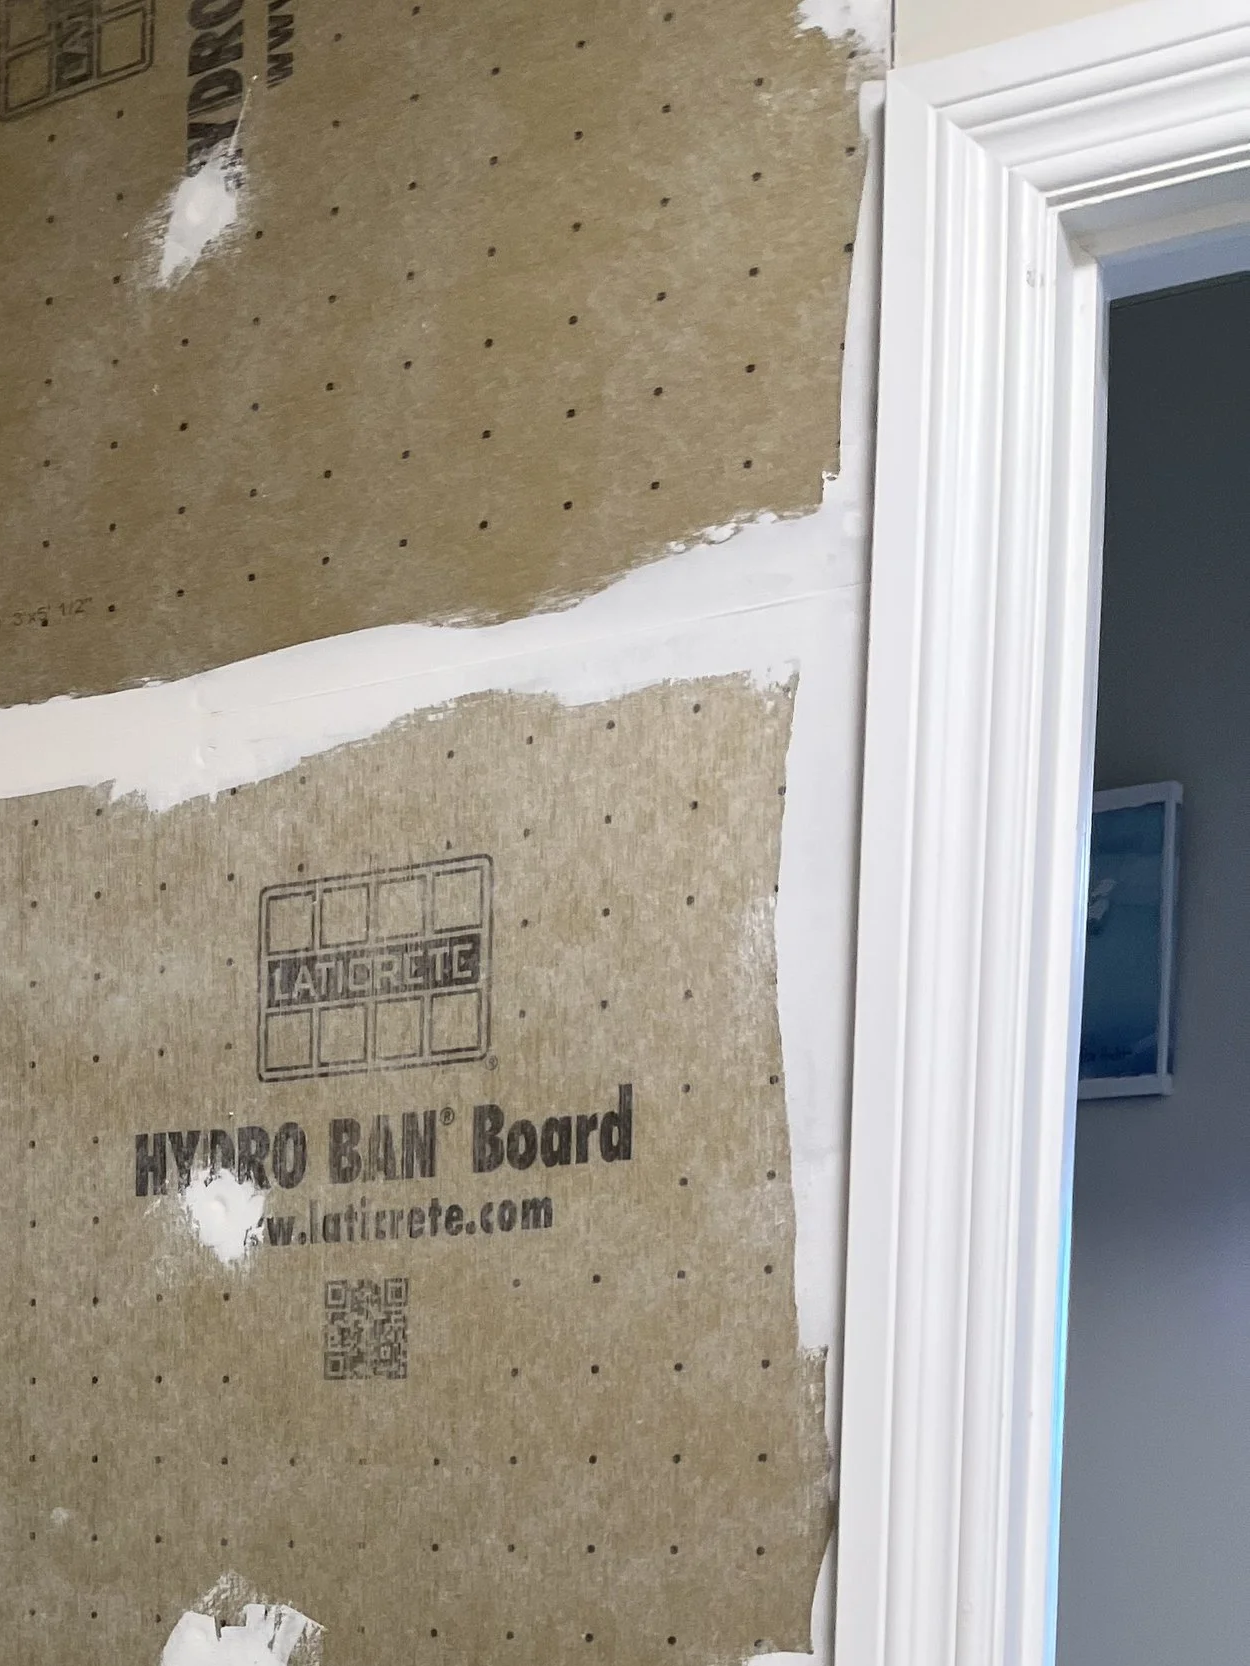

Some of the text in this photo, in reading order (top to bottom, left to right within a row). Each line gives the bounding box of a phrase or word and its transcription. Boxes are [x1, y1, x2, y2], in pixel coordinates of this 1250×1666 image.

[271, 942, 475, 1000] LATICRETE
[473, 1083, 634, 1174] Board
[244, 1195, 555, 1248] w.laticrete.com
